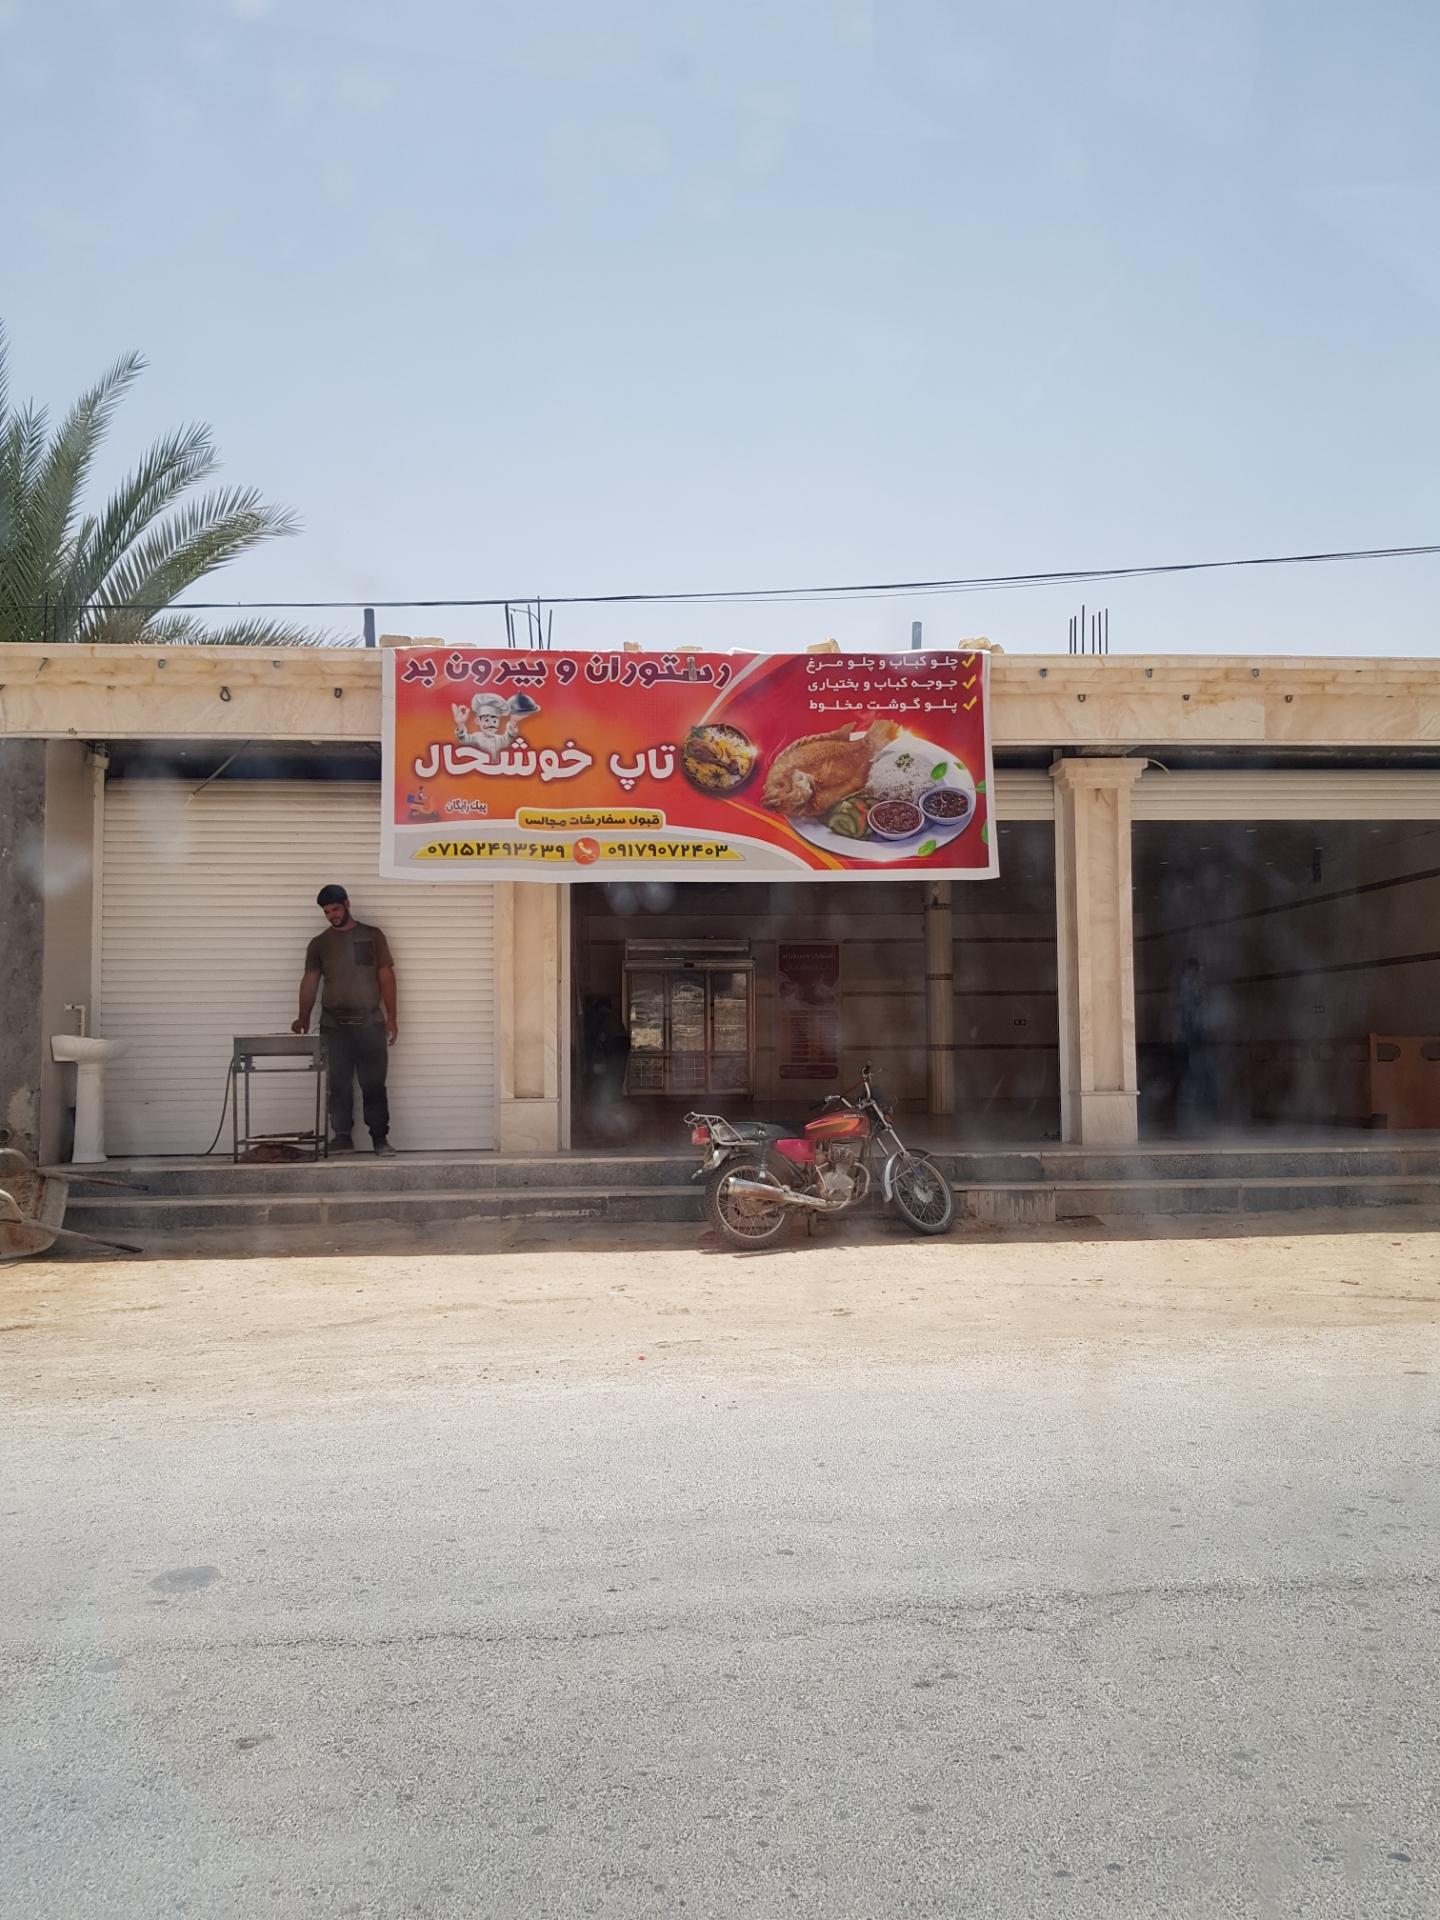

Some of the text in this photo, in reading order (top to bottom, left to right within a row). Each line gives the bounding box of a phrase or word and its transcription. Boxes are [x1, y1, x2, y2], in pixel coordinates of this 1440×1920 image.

[401, 653, 731, 688] رستوران و بیرون بر
[806, 656, 958, 673] چلو کباب و چلو مرغ
[808, 677, 958, 692] جوجه کباب و بختیاری
[809, 697, 957, 713] پلو گوشت مخلوط
[415, 738, 676, 789] تاپ خوشحال
[446, 799, 470, 813] رایگان
[525, 814, 660, 828] قبول سفارشات مجالس
[428, 842, 565, 858] ۰۷۱۵۲۴۹۳۶۳۹
[608, 843, 728, 858] ۰۹۱۷۹۰۷۲۴۰۳
